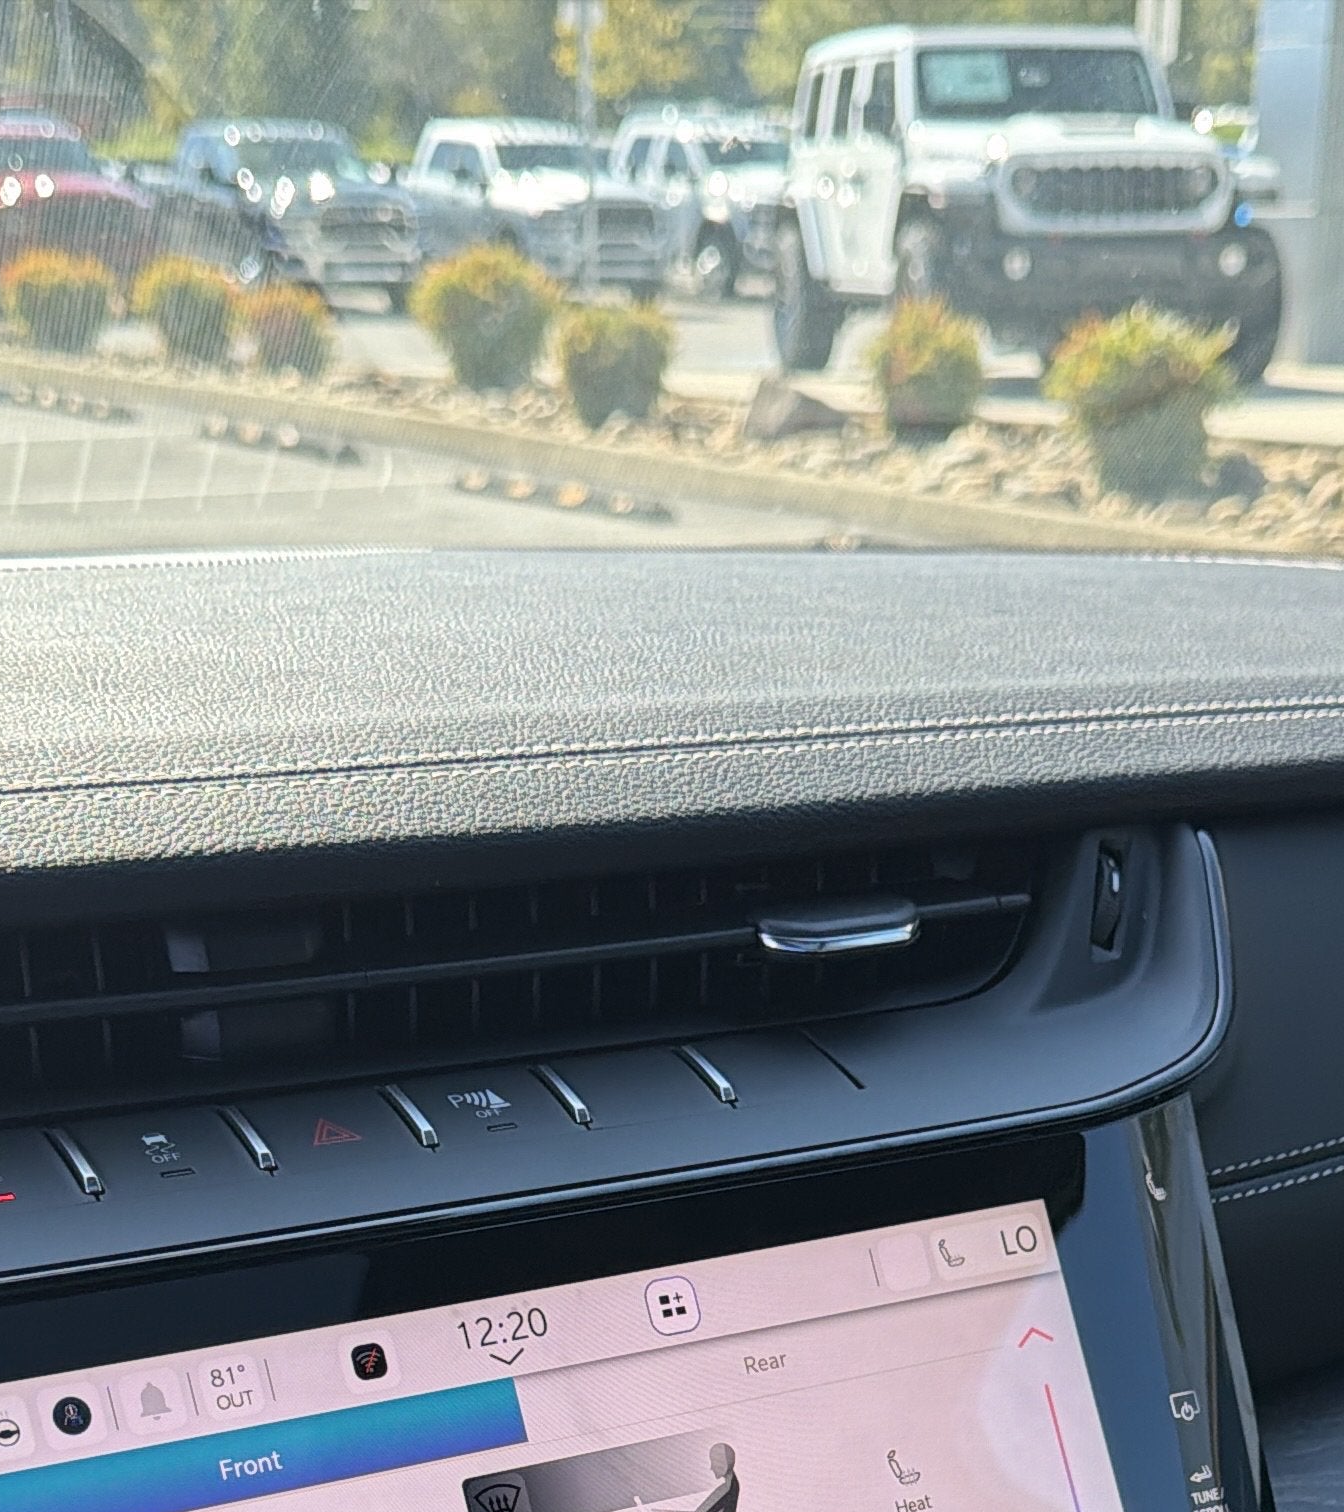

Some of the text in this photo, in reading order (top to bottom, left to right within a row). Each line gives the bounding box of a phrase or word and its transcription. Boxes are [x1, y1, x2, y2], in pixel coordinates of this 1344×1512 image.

[475, 1108, 502, 1119] OFF
[151, 1152, 182, 1165] OFF
[1000, 1225, 1038, 1258] LO
[457, 1307, 549, 1352] 12:20
[744, 1351, 788, 1376] Rear
[216, 1389, 254, 1411] OUT
[219, 1449, 283, 1482] Front
